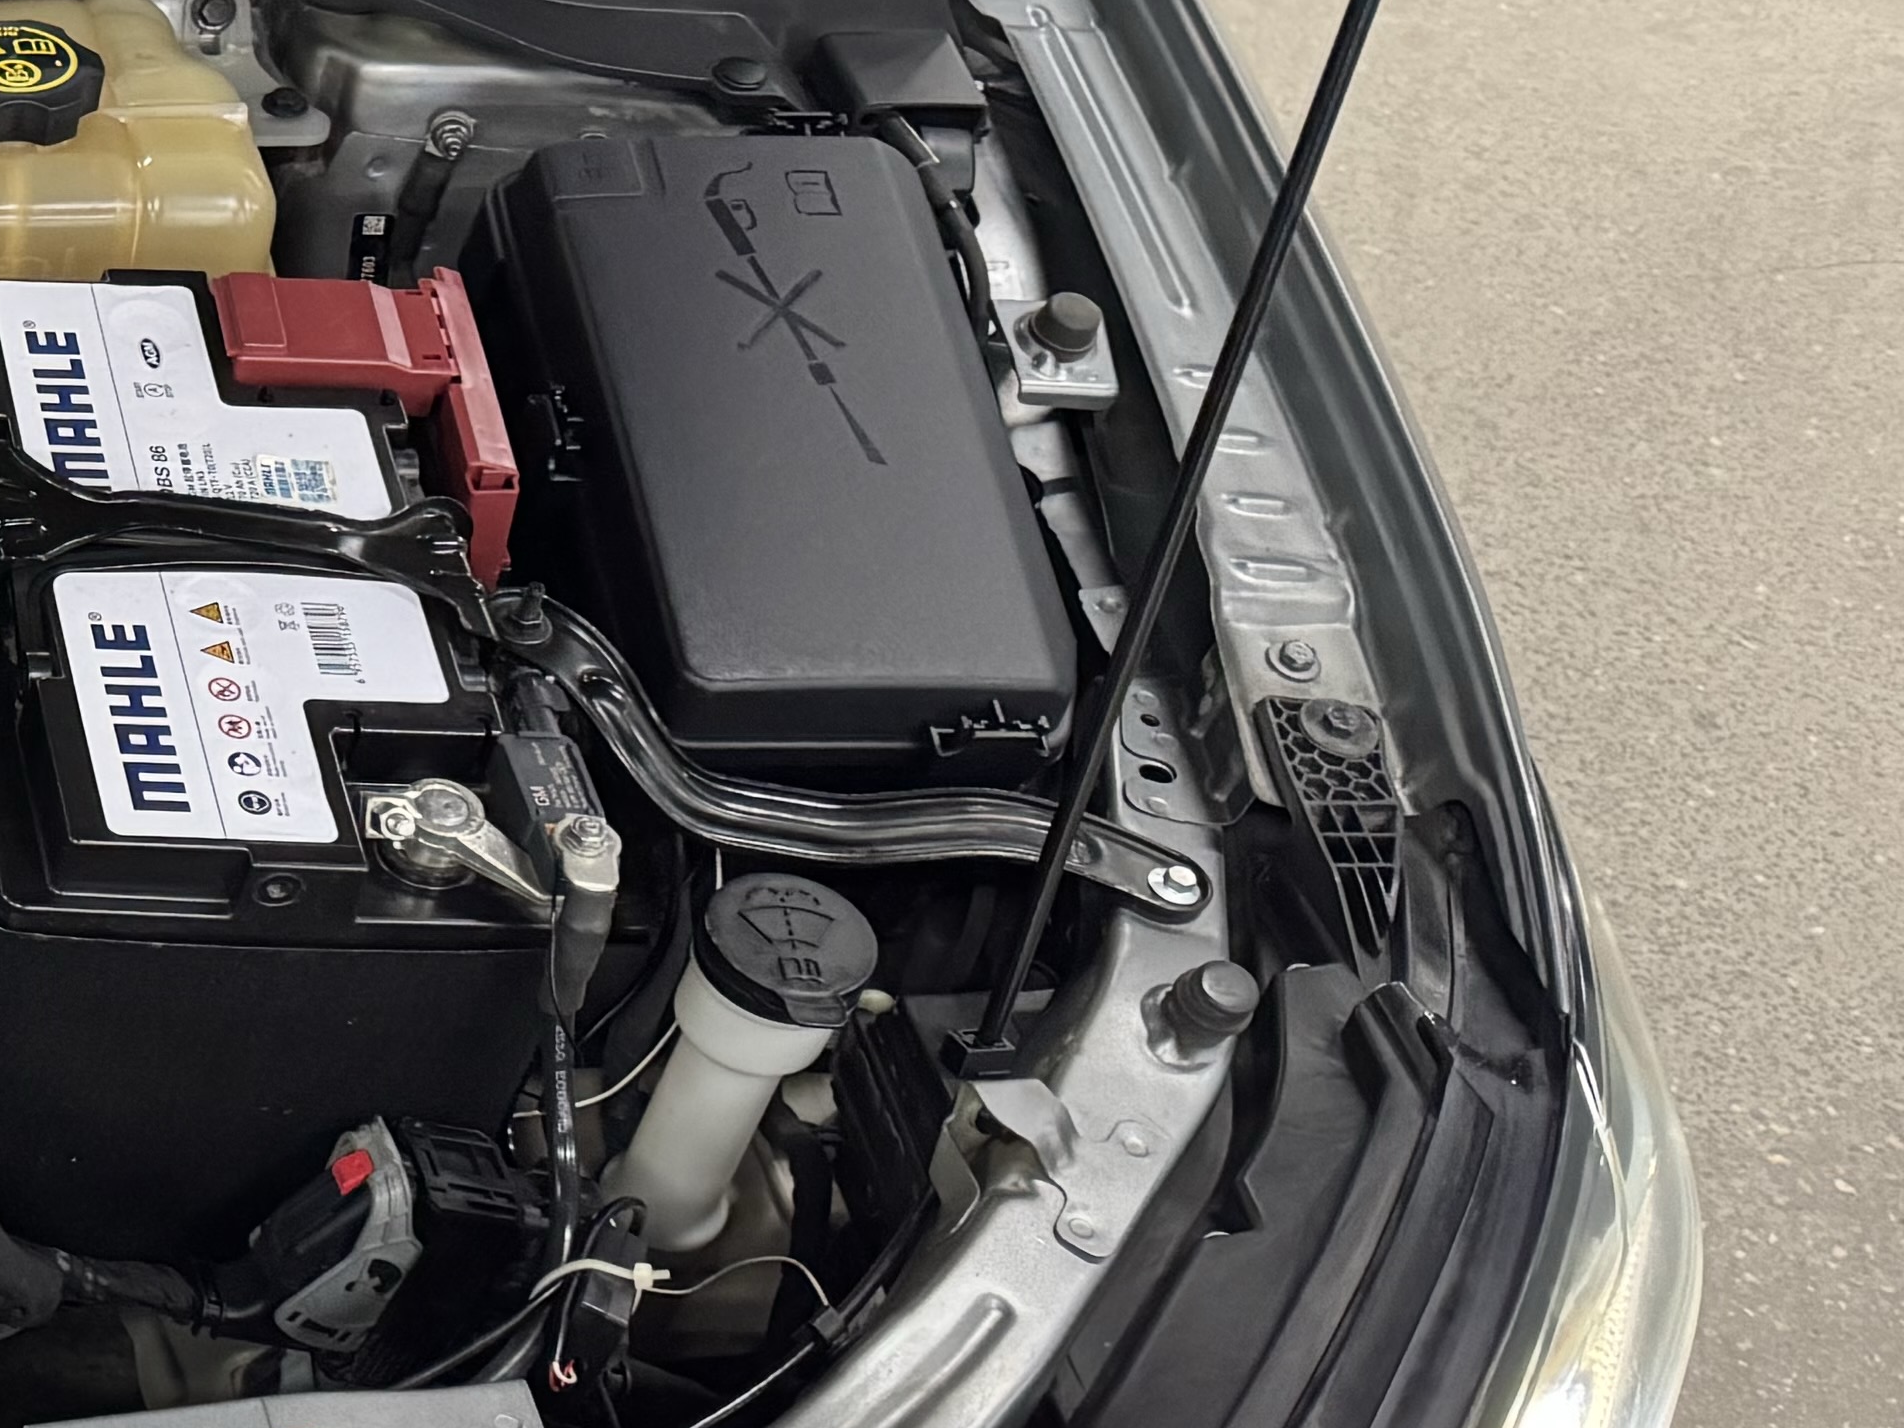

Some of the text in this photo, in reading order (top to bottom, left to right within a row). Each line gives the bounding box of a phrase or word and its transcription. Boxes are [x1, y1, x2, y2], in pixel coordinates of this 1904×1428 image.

[360, 256, 376, 280] 7603
[142, 341, 160, 366] AGM
[25, 330, 112, 493] MAHLE
[149, 445, 168, 464] 86
[90, 624, 191, 812] MAHLE
[530, 785, 551, 807] GM
